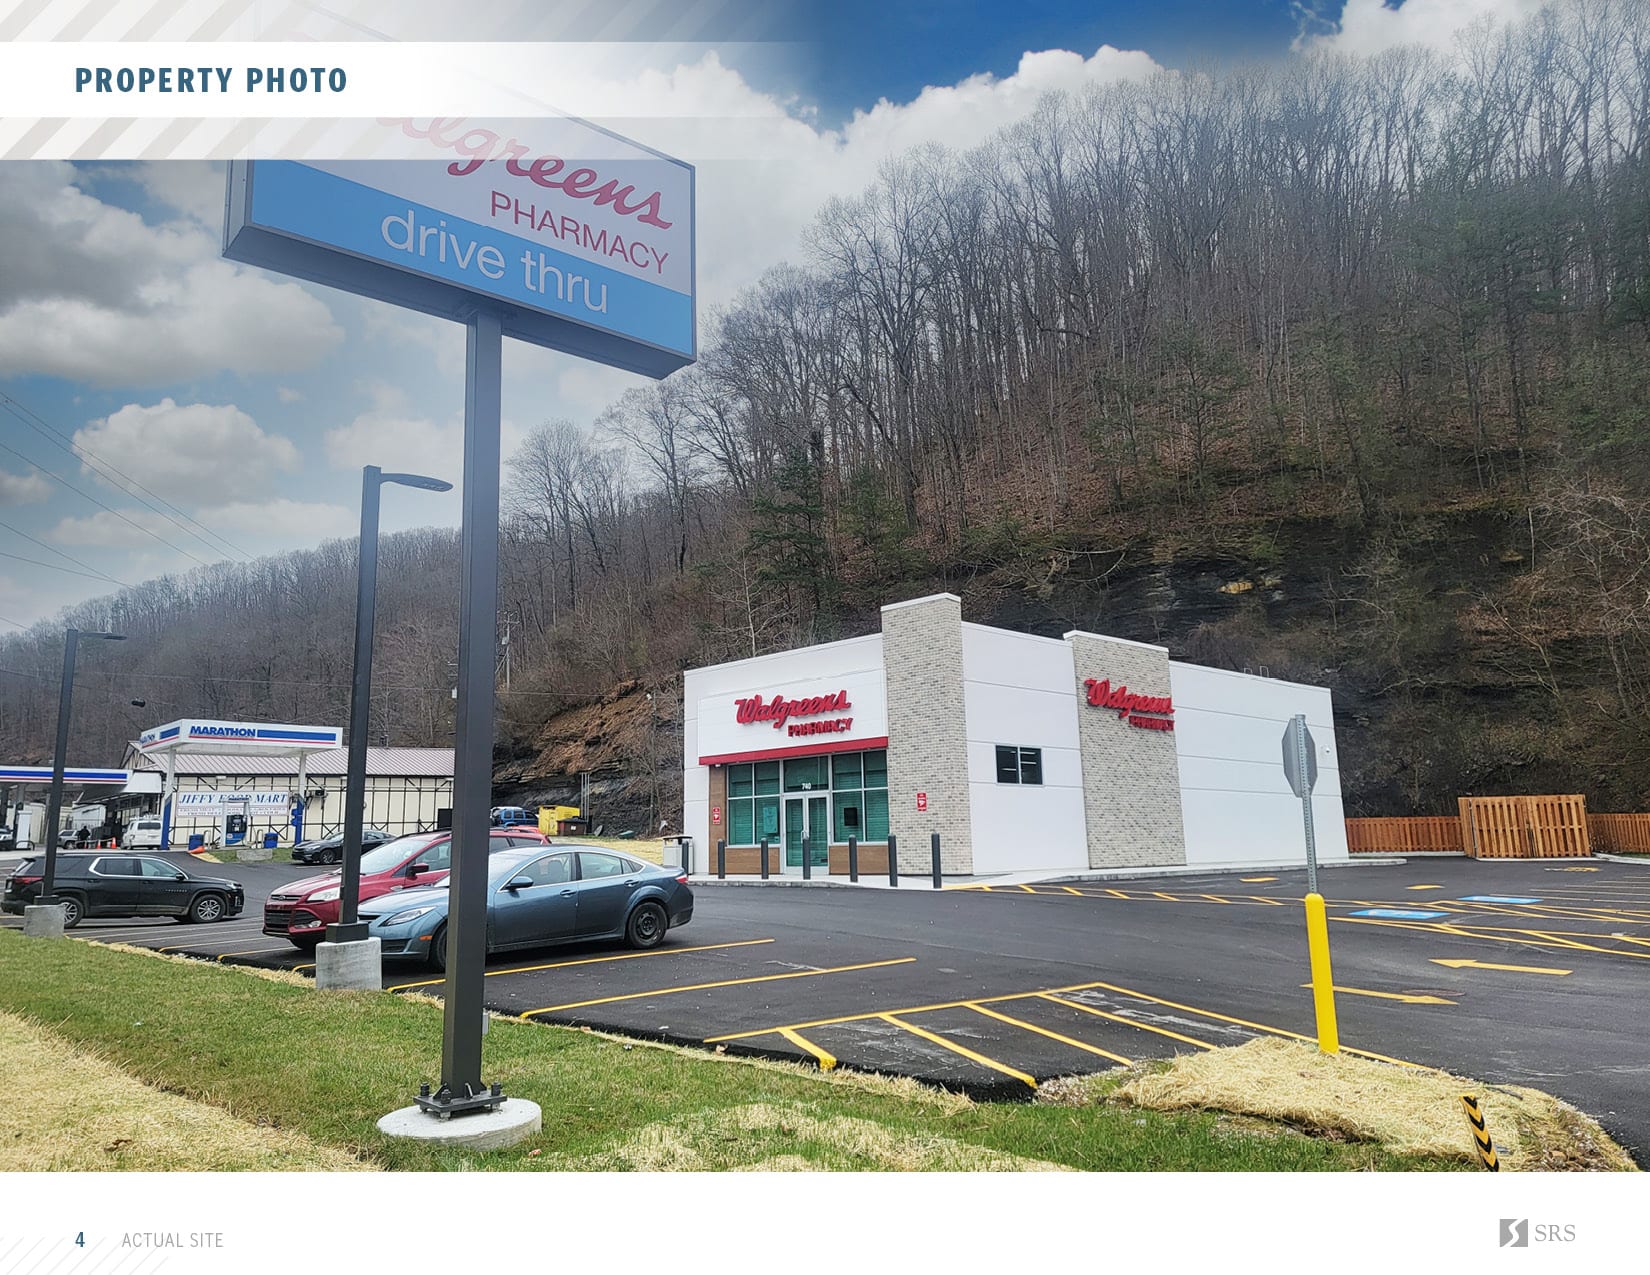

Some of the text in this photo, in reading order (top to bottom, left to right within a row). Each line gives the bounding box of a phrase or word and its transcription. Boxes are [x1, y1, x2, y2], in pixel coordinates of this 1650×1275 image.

[376, 117, 673, 230] lgreens
[490, 190, 670, 275] PHARMACY
[381, 209, 608, 314] drive thru
[734, 690, 852, 728] Walgreens
[788, 718, 854, 737] PHARMACY
[190, 726, 256, 737] MARATHON
[179, 794, 216, 804] JIFFY
[254, 794, 288, 803] MART
